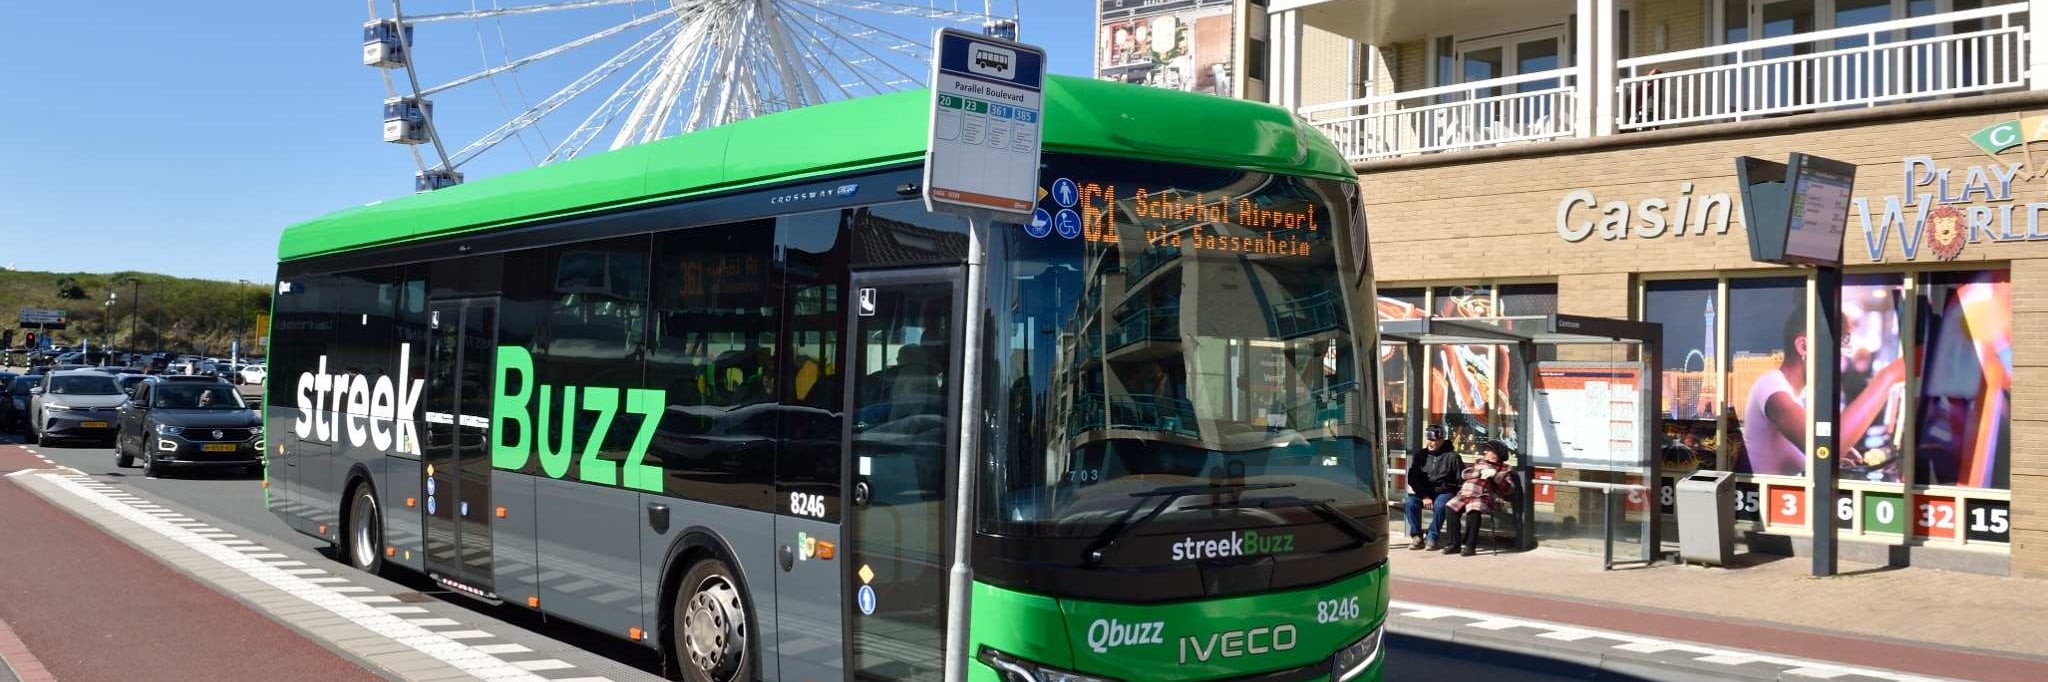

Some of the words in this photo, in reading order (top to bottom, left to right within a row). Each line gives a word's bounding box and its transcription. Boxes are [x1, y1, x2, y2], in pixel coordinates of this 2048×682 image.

[939, 95, 951, 106] 20
[954, 80, 984, 95] Parallel
[986, 86, 1025, 103] Boulevard
[964, 100, 977, 111] 23
[990, 105, 1007, 117] 361
[1014, 110, 1032, 122] 385
[1903, 155, 2023, 208] PLAY
[1078, 181, 1120, 244] 61
[1135, 187, 1229, 224] Schiphol
[1239, 198, 1318, 232] Airport
[1556, 181, 1748, 243] Casin
[1147, 225, 1182, 248] via
[1192, 225, 1310, 257] Sassenheim
[295, 342, 425, 456] streek
[491, 345, 667, 494] Buzz
[790, 491, 826, 518] 8246
[1780, 493, 1798, 516] 3
[1875, 500, 1895, 524] 0
[1918, 504, 1954, 529] 32
[1970, 507, 2009, 533] 15
[1316, 595, 1360, 624] 8246
[1087, 618, 1165, 654] Qbuzz
[1178, 623, 1297, 664] IVECO
